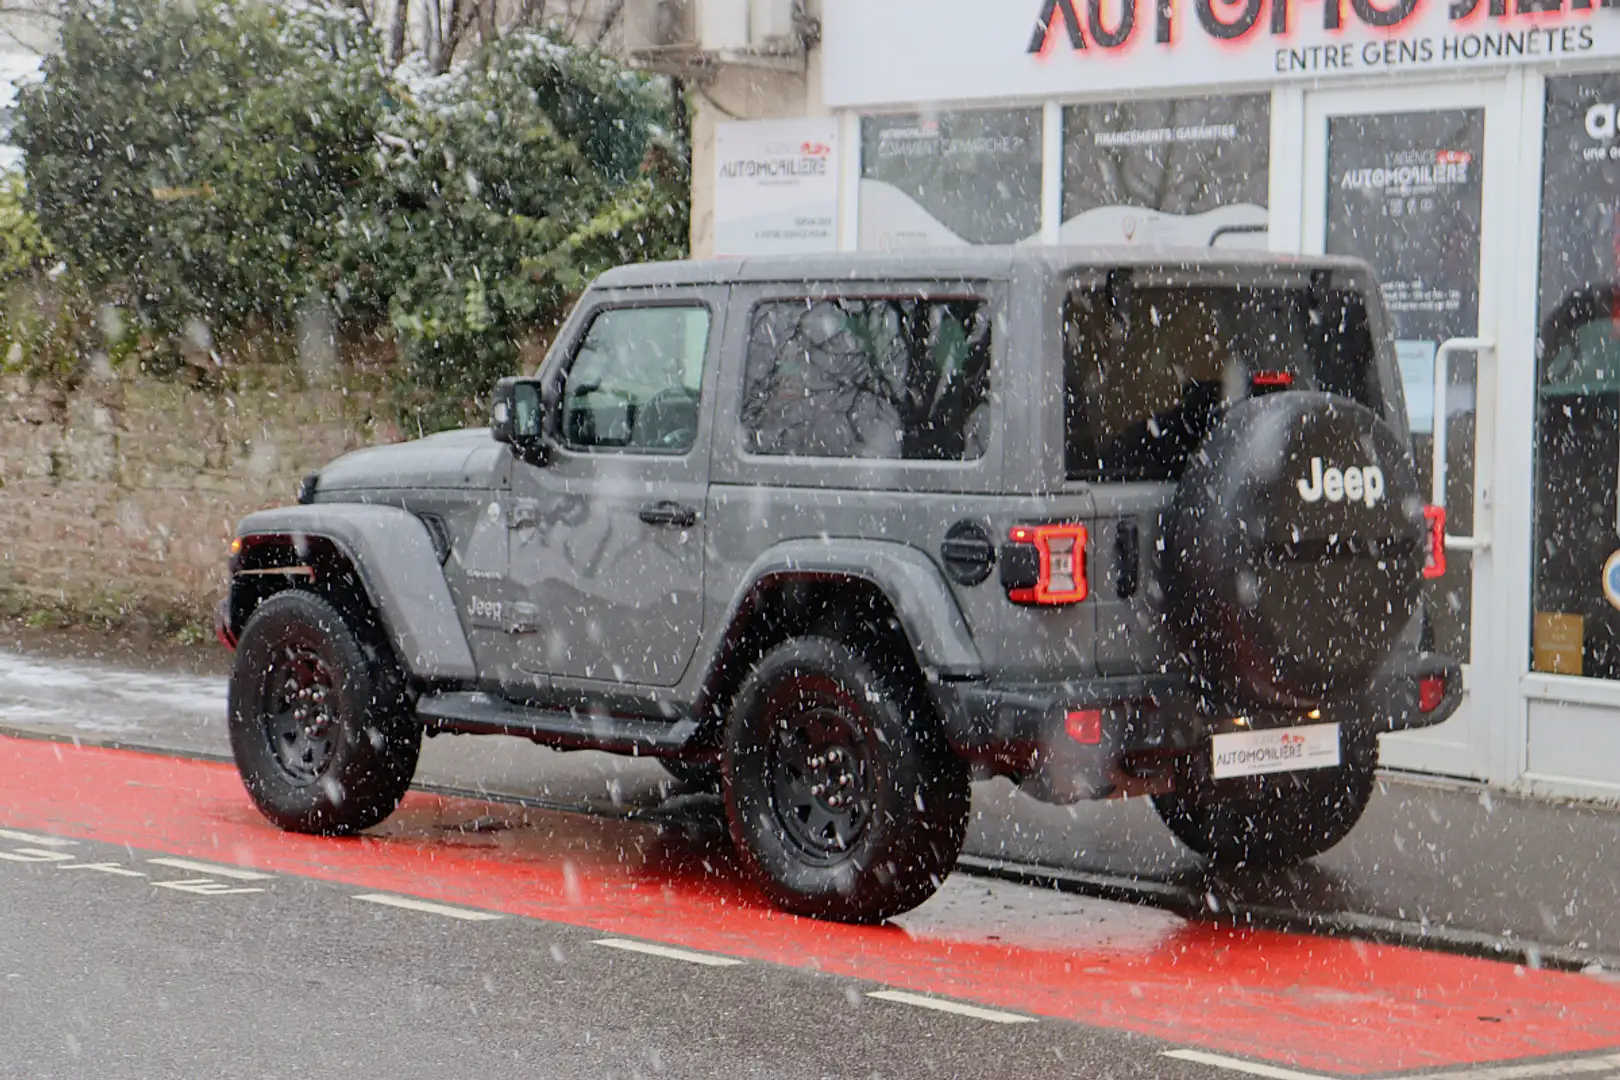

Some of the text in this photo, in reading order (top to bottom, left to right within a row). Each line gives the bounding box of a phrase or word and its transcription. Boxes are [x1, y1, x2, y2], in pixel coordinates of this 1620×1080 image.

[1275, 24, 1593, 72] ENTRE GENS HONNÊTES
[1296, 456, 1385, 508] Jeep
[467, 595, 502, 620] Jeep
